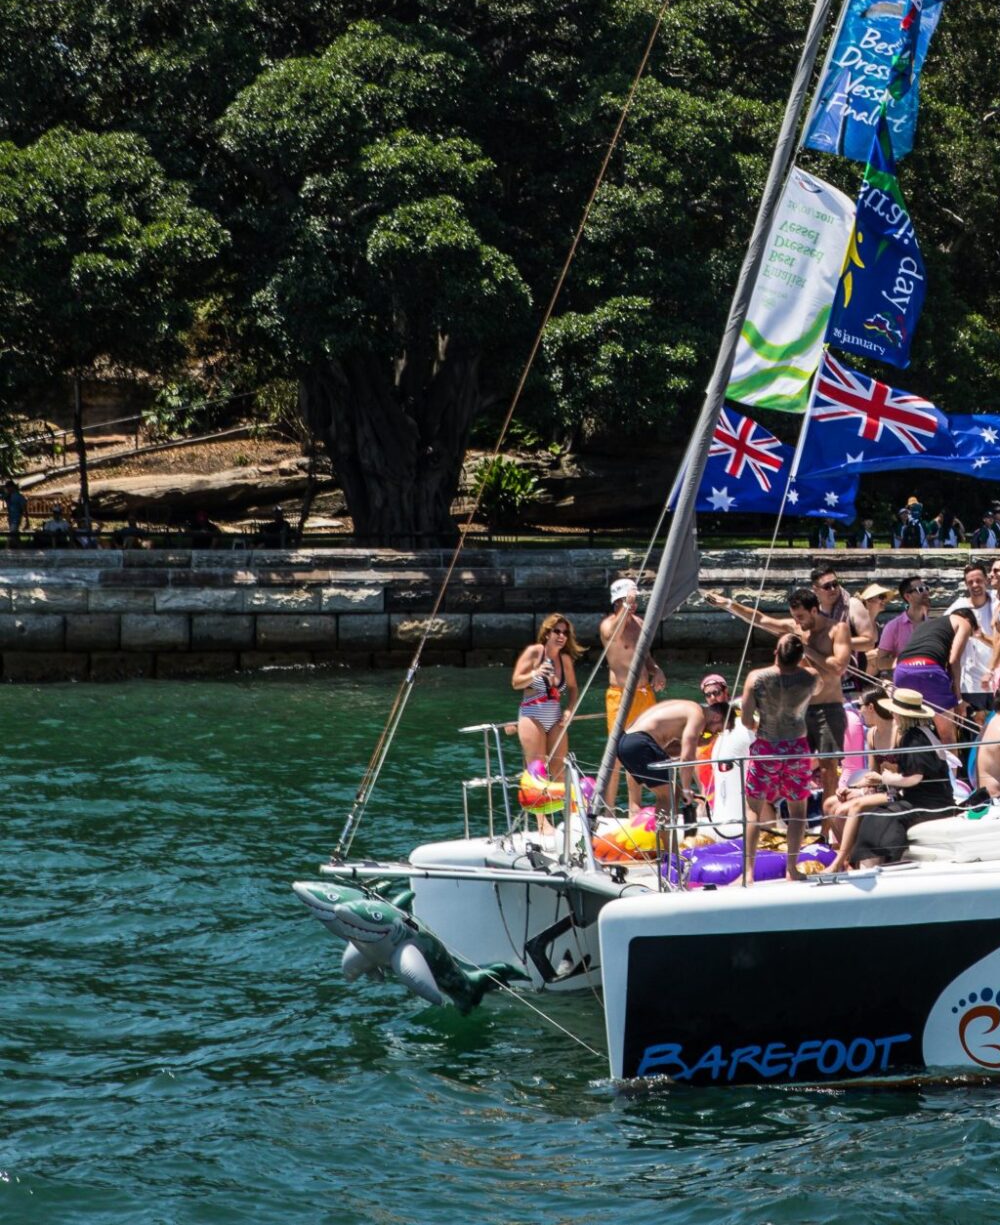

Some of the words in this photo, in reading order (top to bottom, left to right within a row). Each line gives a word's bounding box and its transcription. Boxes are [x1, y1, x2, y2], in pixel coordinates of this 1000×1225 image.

[859, 27, 895, 55] Bes
[839, 46, 891, 79] Dress
[881, 256, 924, 314] day
[840, 328, 886, 355] january
[637, 1033, 911, 1080] BAREFOOT
